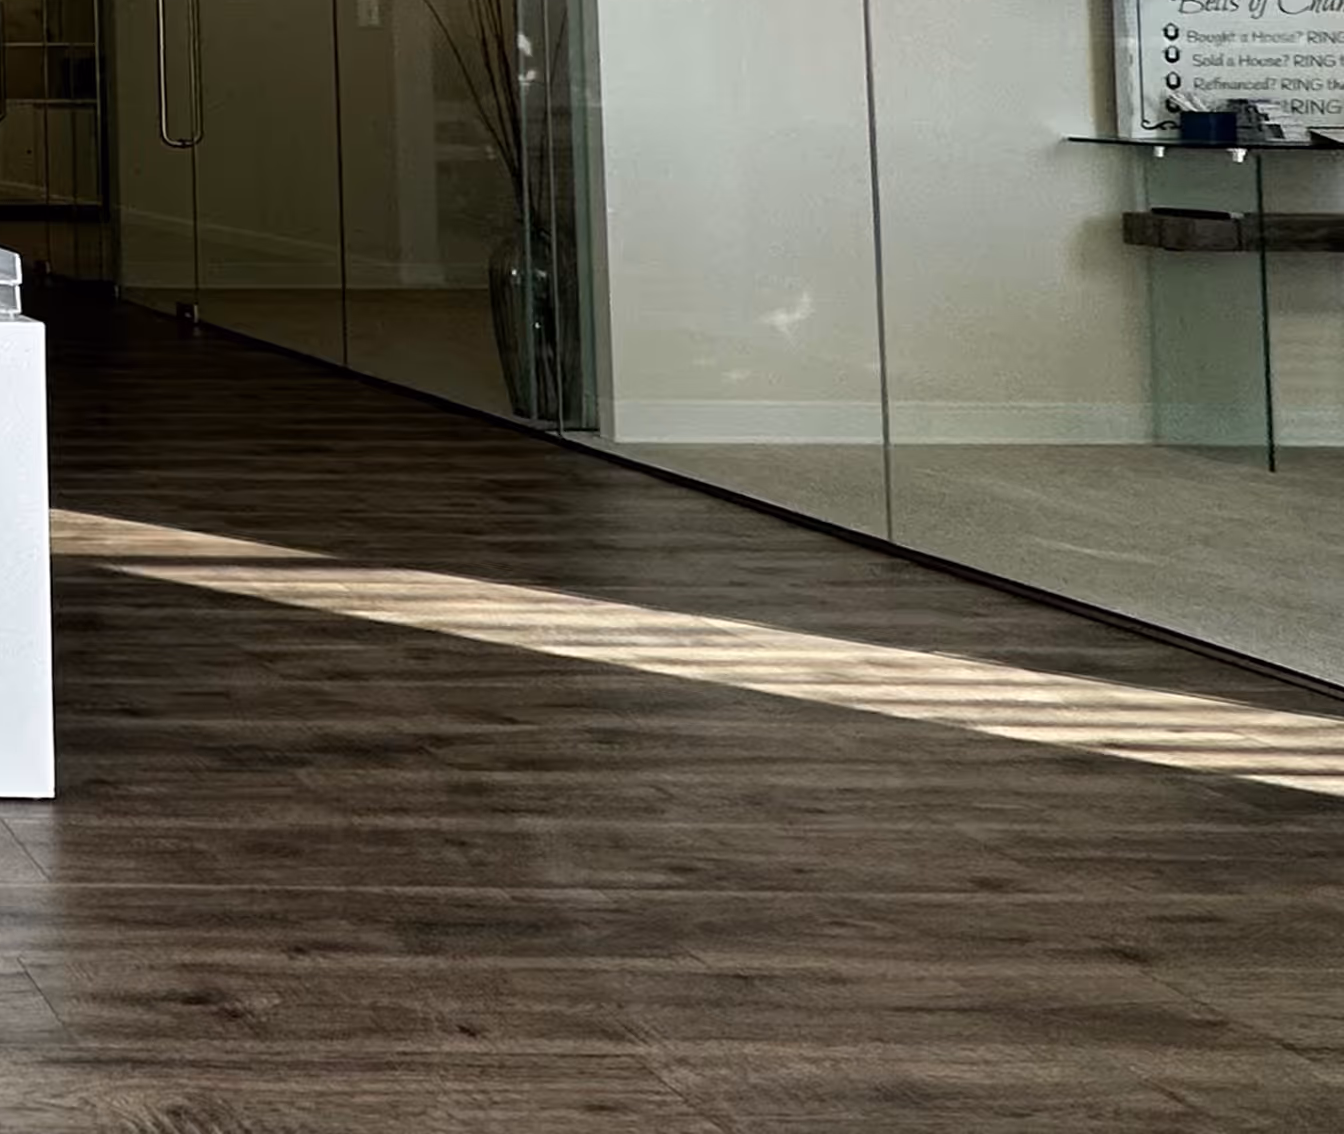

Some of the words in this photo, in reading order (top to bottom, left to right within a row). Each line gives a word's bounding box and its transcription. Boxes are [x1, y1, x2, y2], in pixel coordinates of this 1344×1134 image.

[1186, 30, 1235, 45] Bought
[1240, 33, 1249, 43] a
[1252, 31, 1303, 43] House?
[1192, 53, 1223, 67] Sold
[1226, 56, 1235, 66] a
[1238, 54, 1290, 67] House?
[1293, 54, 1337, 67] RING
[1193, 77, 1277, 91] Refinanced?
[1280, 78, 1324, 91] RING
[1290, 98, 1342, 114] RING
